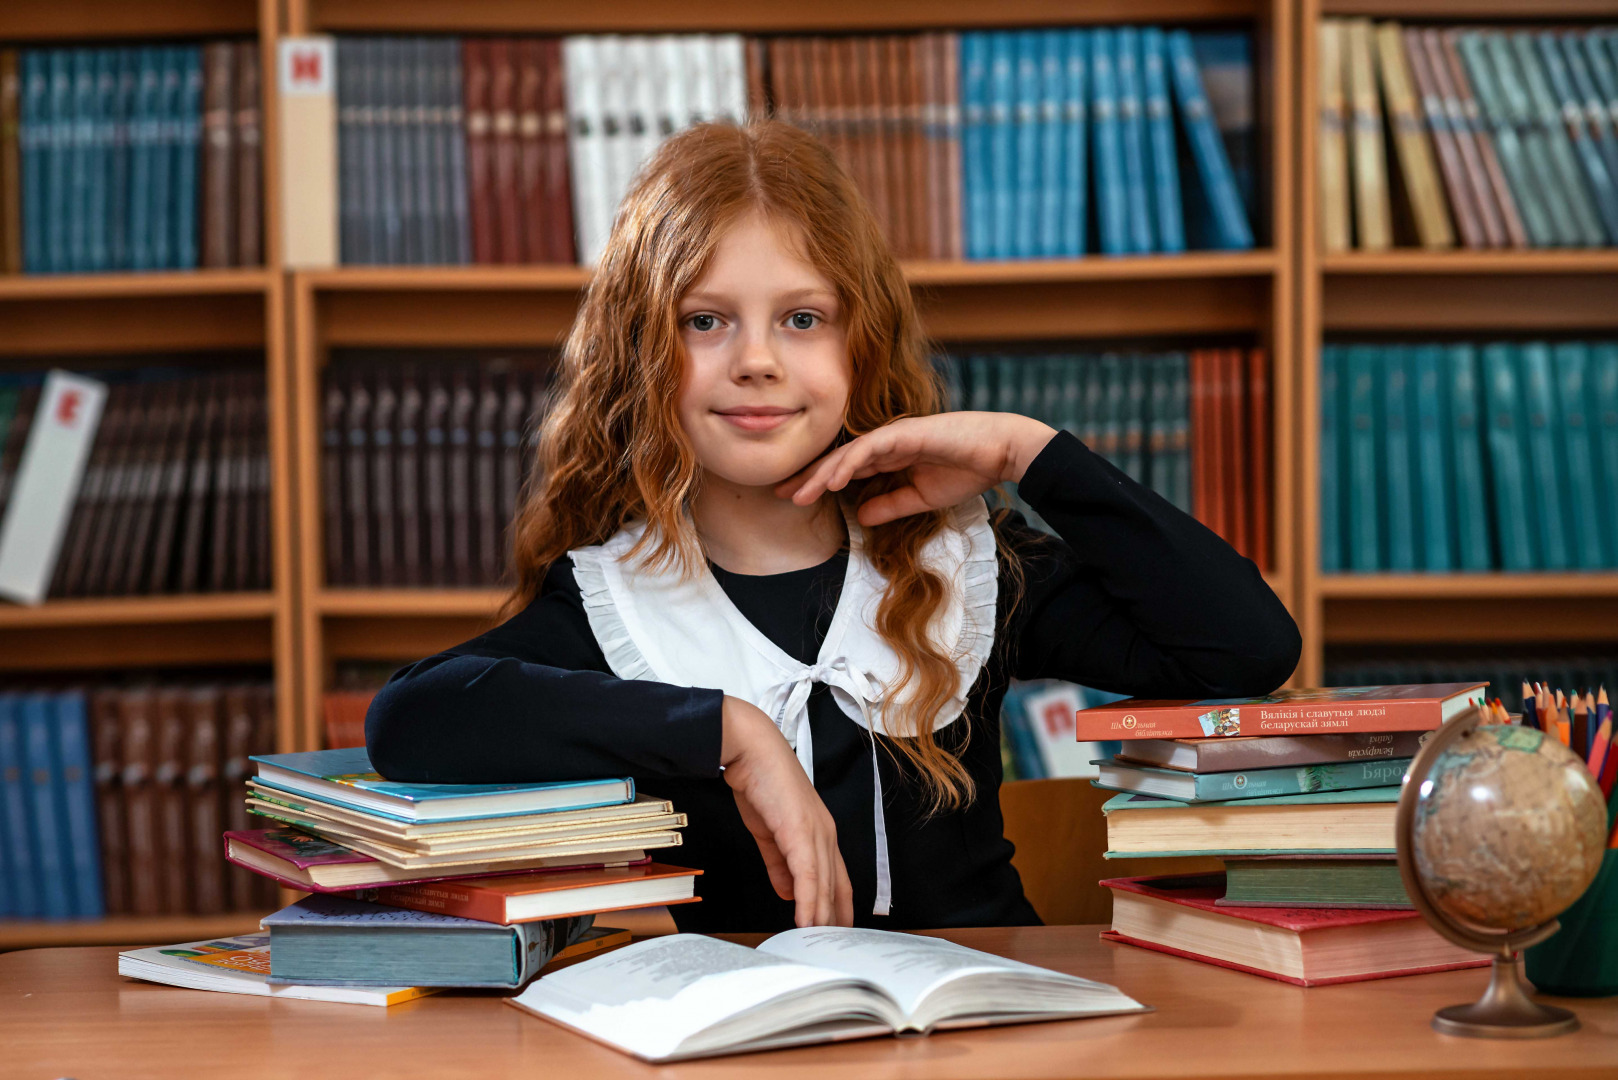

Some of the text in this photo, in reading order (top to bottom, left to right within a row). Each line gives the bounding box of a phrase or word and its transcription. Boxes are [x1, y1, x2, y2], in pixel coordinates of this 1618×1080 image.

[1261, 706, 1386, 720] Вялікія і славутыя людзі
[1260, 718, 1348, 731] беларускай зямлі
[1348, 746, 1394, 758] Беларускія
